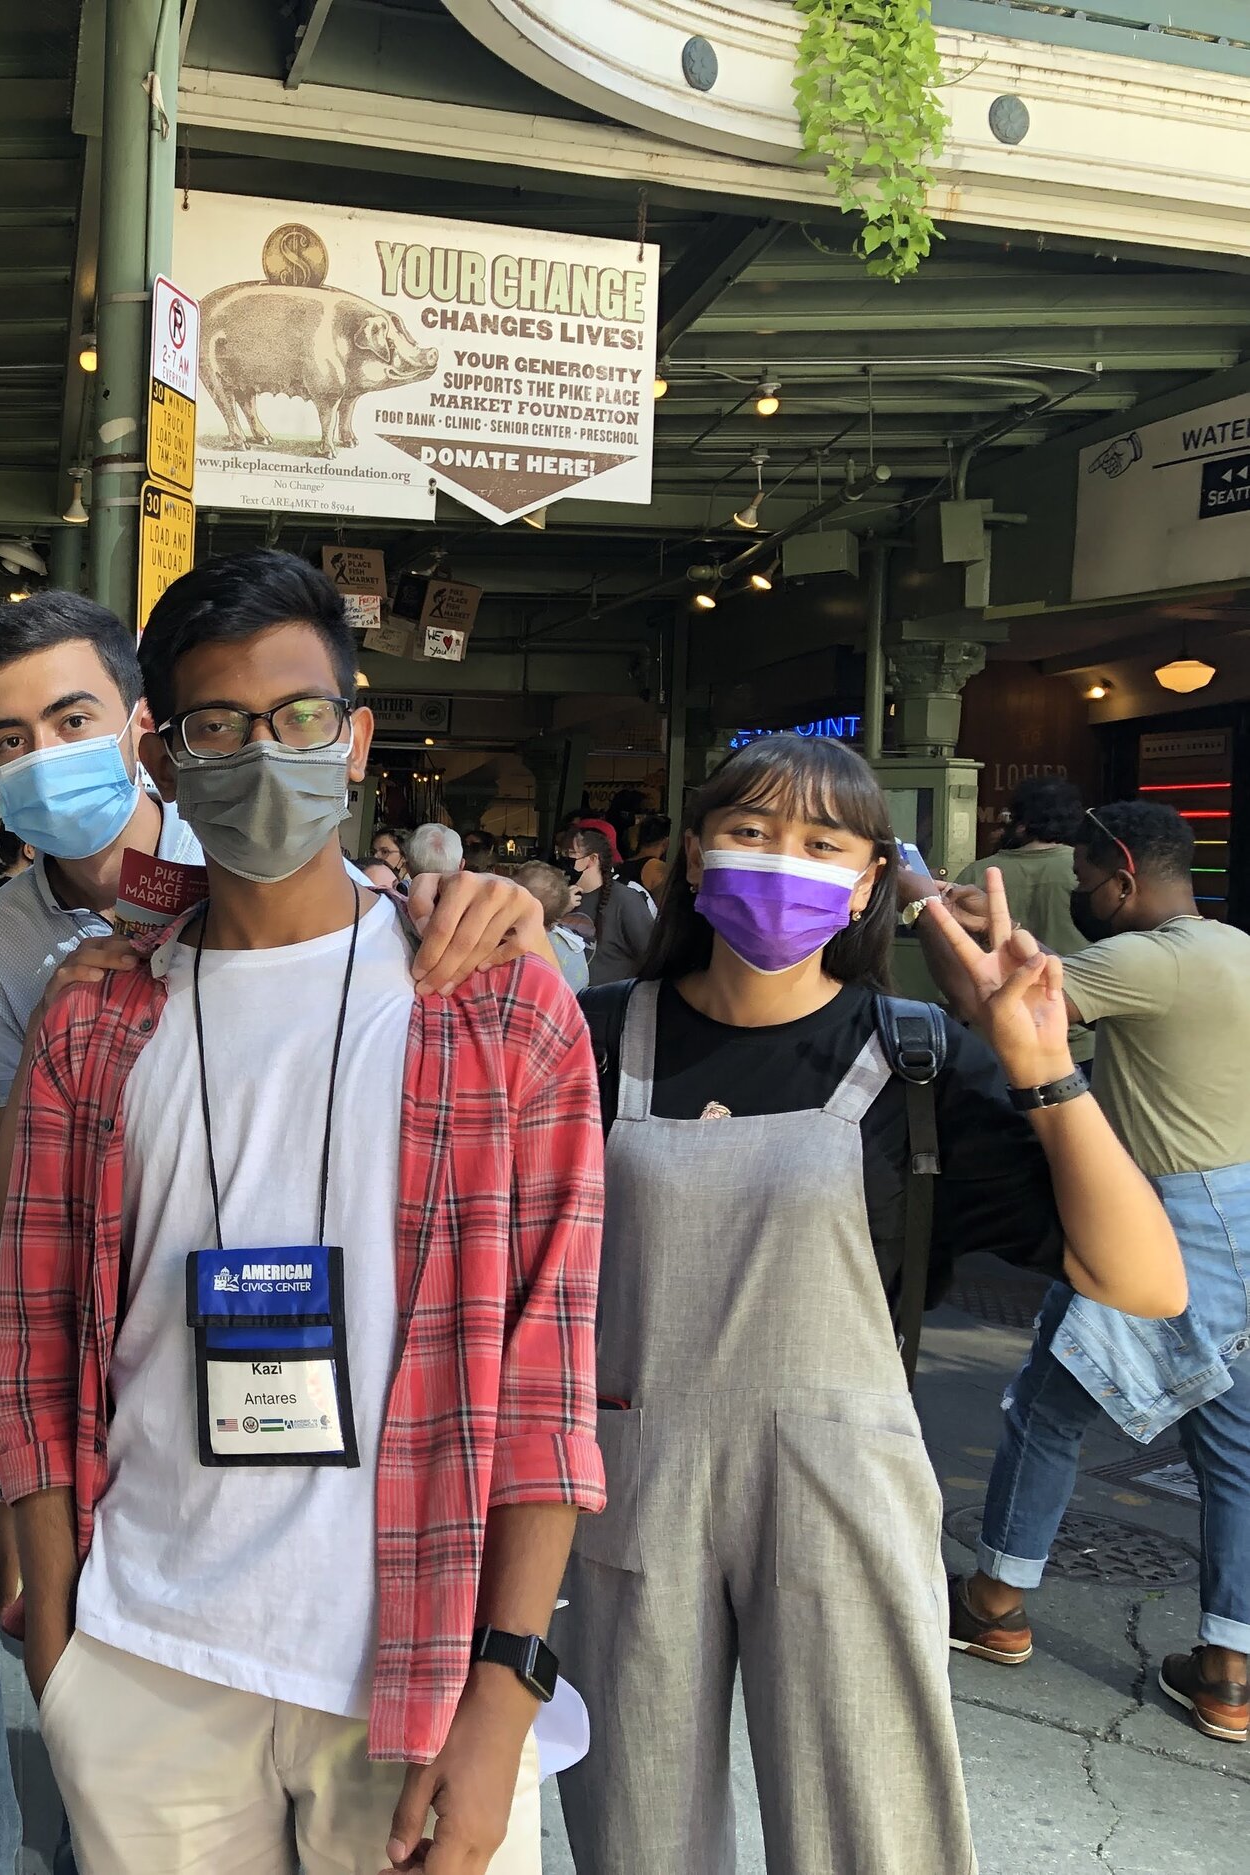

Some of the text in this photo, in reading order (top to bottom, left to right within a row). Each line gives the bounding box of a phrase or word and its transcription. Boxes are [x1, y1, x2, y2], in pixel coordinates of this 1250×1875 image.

[375, 240, 646, 323] YOUR CHANGE
[421, 307, 644, 350] CHANGES LIVES!
[179, 358, 190, 377] AM
[454, 351, 642, 384] YOUR GENEROSITY
[162, 366, 188, 392] EVERYDAY
[443, 372, 640, 407] SUPPORTS THE PIKE PLACE
[153, 381, 191, 418] 30 MINUTE
[430, 393, 639, 426] MARKET FOUNDATION
[163, 410, 184, 435] TRUCK
[375, 409, 639, 445] FOOD BANK CLINIC SENIOR CENTER PRESCHOOL
[155, 426, 189, 456] LOAD ONLY
[420, 445, 595, 477] DONATE HERE!
[274, 479, 325, 492] No Change?
[146, 492, 190, 524] 30 MINUTE
[240, 495, 259, 505] Text
[261, 497, 319, 510] CARE4MKT
[331, 501, 355, 513] 85944
[149, 524, 187, 551] LOAD AND
[151, 548, 183, 573] UNLOAD
[347, 552, 364, 561] PIKE
[347, 560, 372, 569] PLACE
[348, 568, 365, 577] FISH
[349, 576, 380, 585] MARKET
[157, 575, 175, 593] ON
[449, 588, 464, 596] PIKE
[446, 596, 469, 605] PLACE
[444, 610, 471, 620] MARKET
[428, 629, 443, 642] WE
[154, 866, 185, 883] PIKE
[139, 875, 183, 897] PLACE
[125, 883, 181, 909] MARKET
[241, 1264, 313, 1281] AMERICAN
[241, 1281, 312, 1293] CIVICS CENTER
[251, 1362, 283, 1376] Kazi
[244, 1392, 298, 1405] Antares
